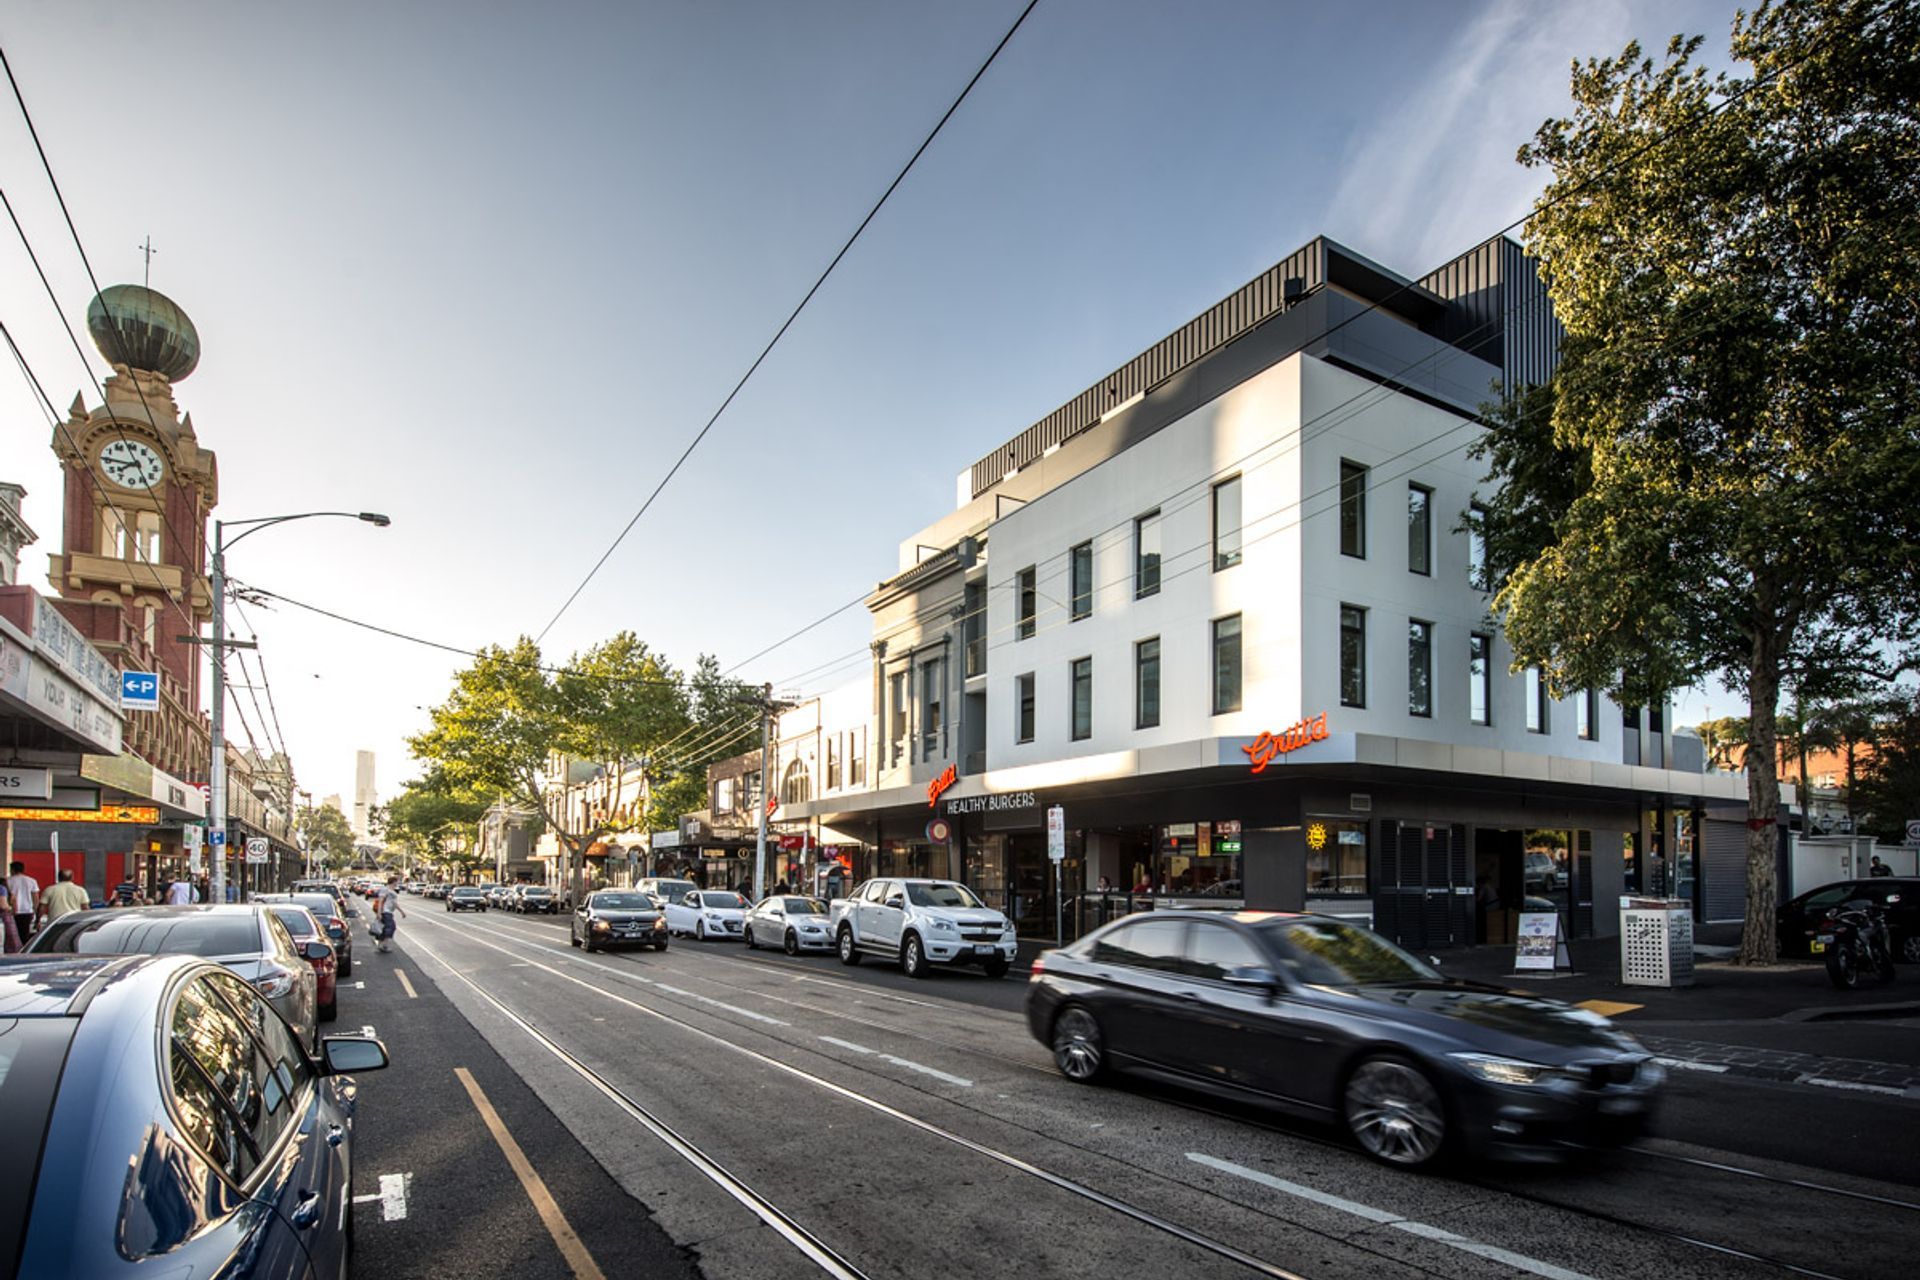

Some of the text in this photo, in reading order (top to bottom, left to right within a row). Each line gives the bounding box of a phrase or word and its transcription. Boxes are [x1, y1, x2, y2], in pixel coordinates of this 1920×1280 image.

[141, 681, 154, 693] P
[947, 792, 1035, 815] HEALTHY BURGERS
